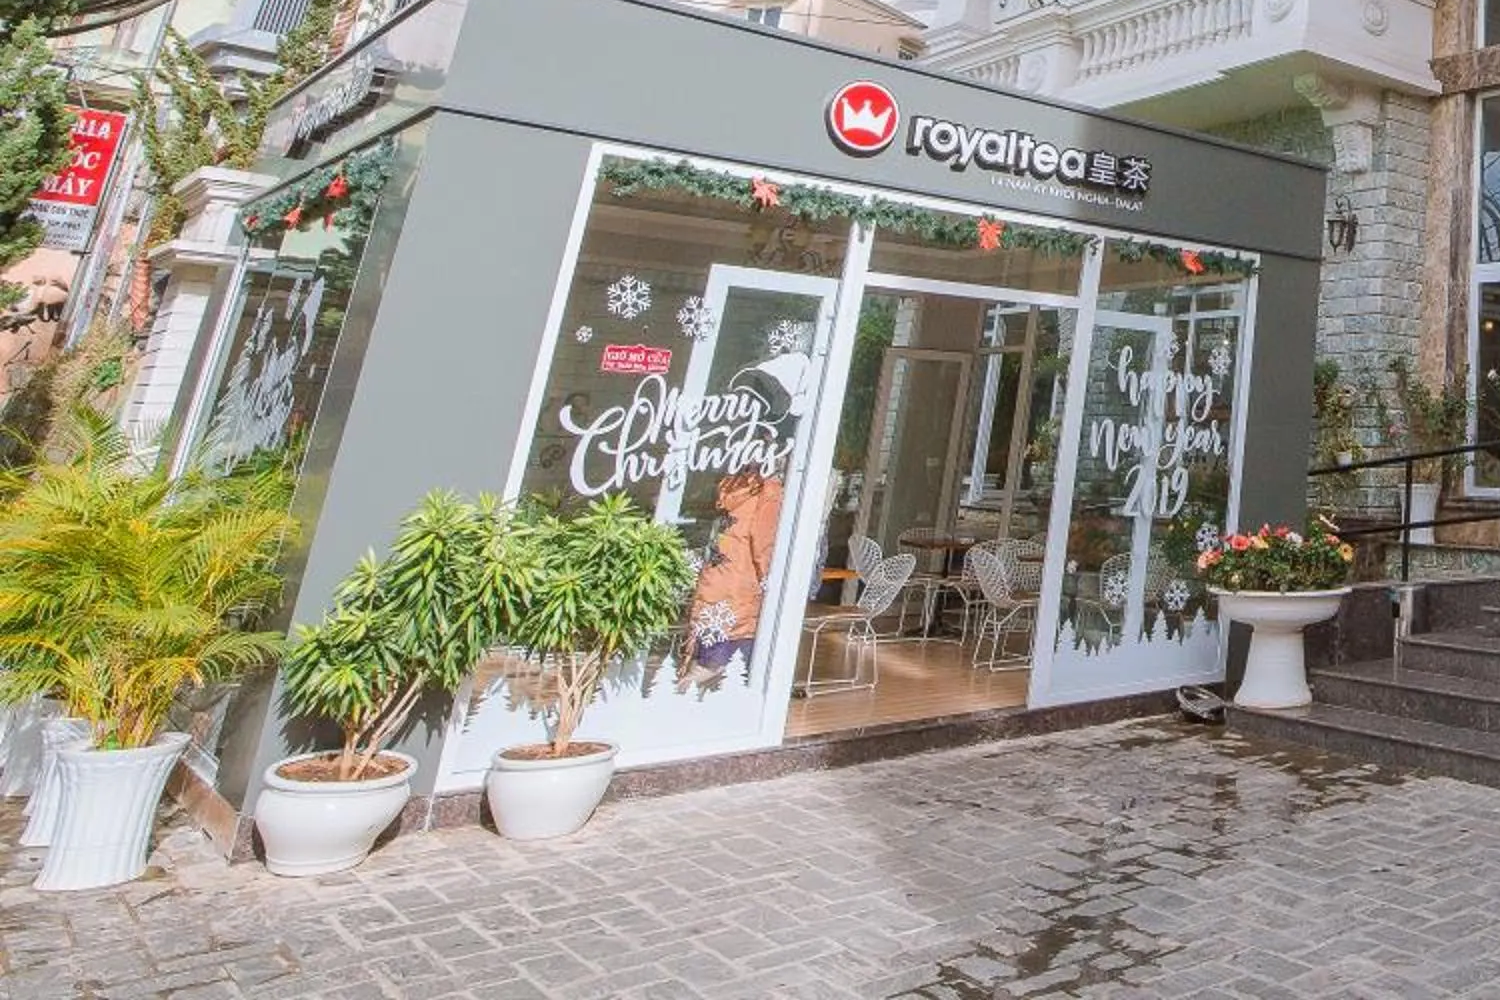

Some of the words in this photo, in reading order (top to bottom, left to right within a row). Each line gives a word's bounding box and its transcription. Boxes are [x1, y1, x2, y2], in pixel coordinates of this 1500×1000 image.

[909, 114, 1088, 181] royaltea
[1089, 151, 1151, 193] 皇茶
[559, 398, 795, 496] Christmas
[634, 374, 773, 444] Merry
